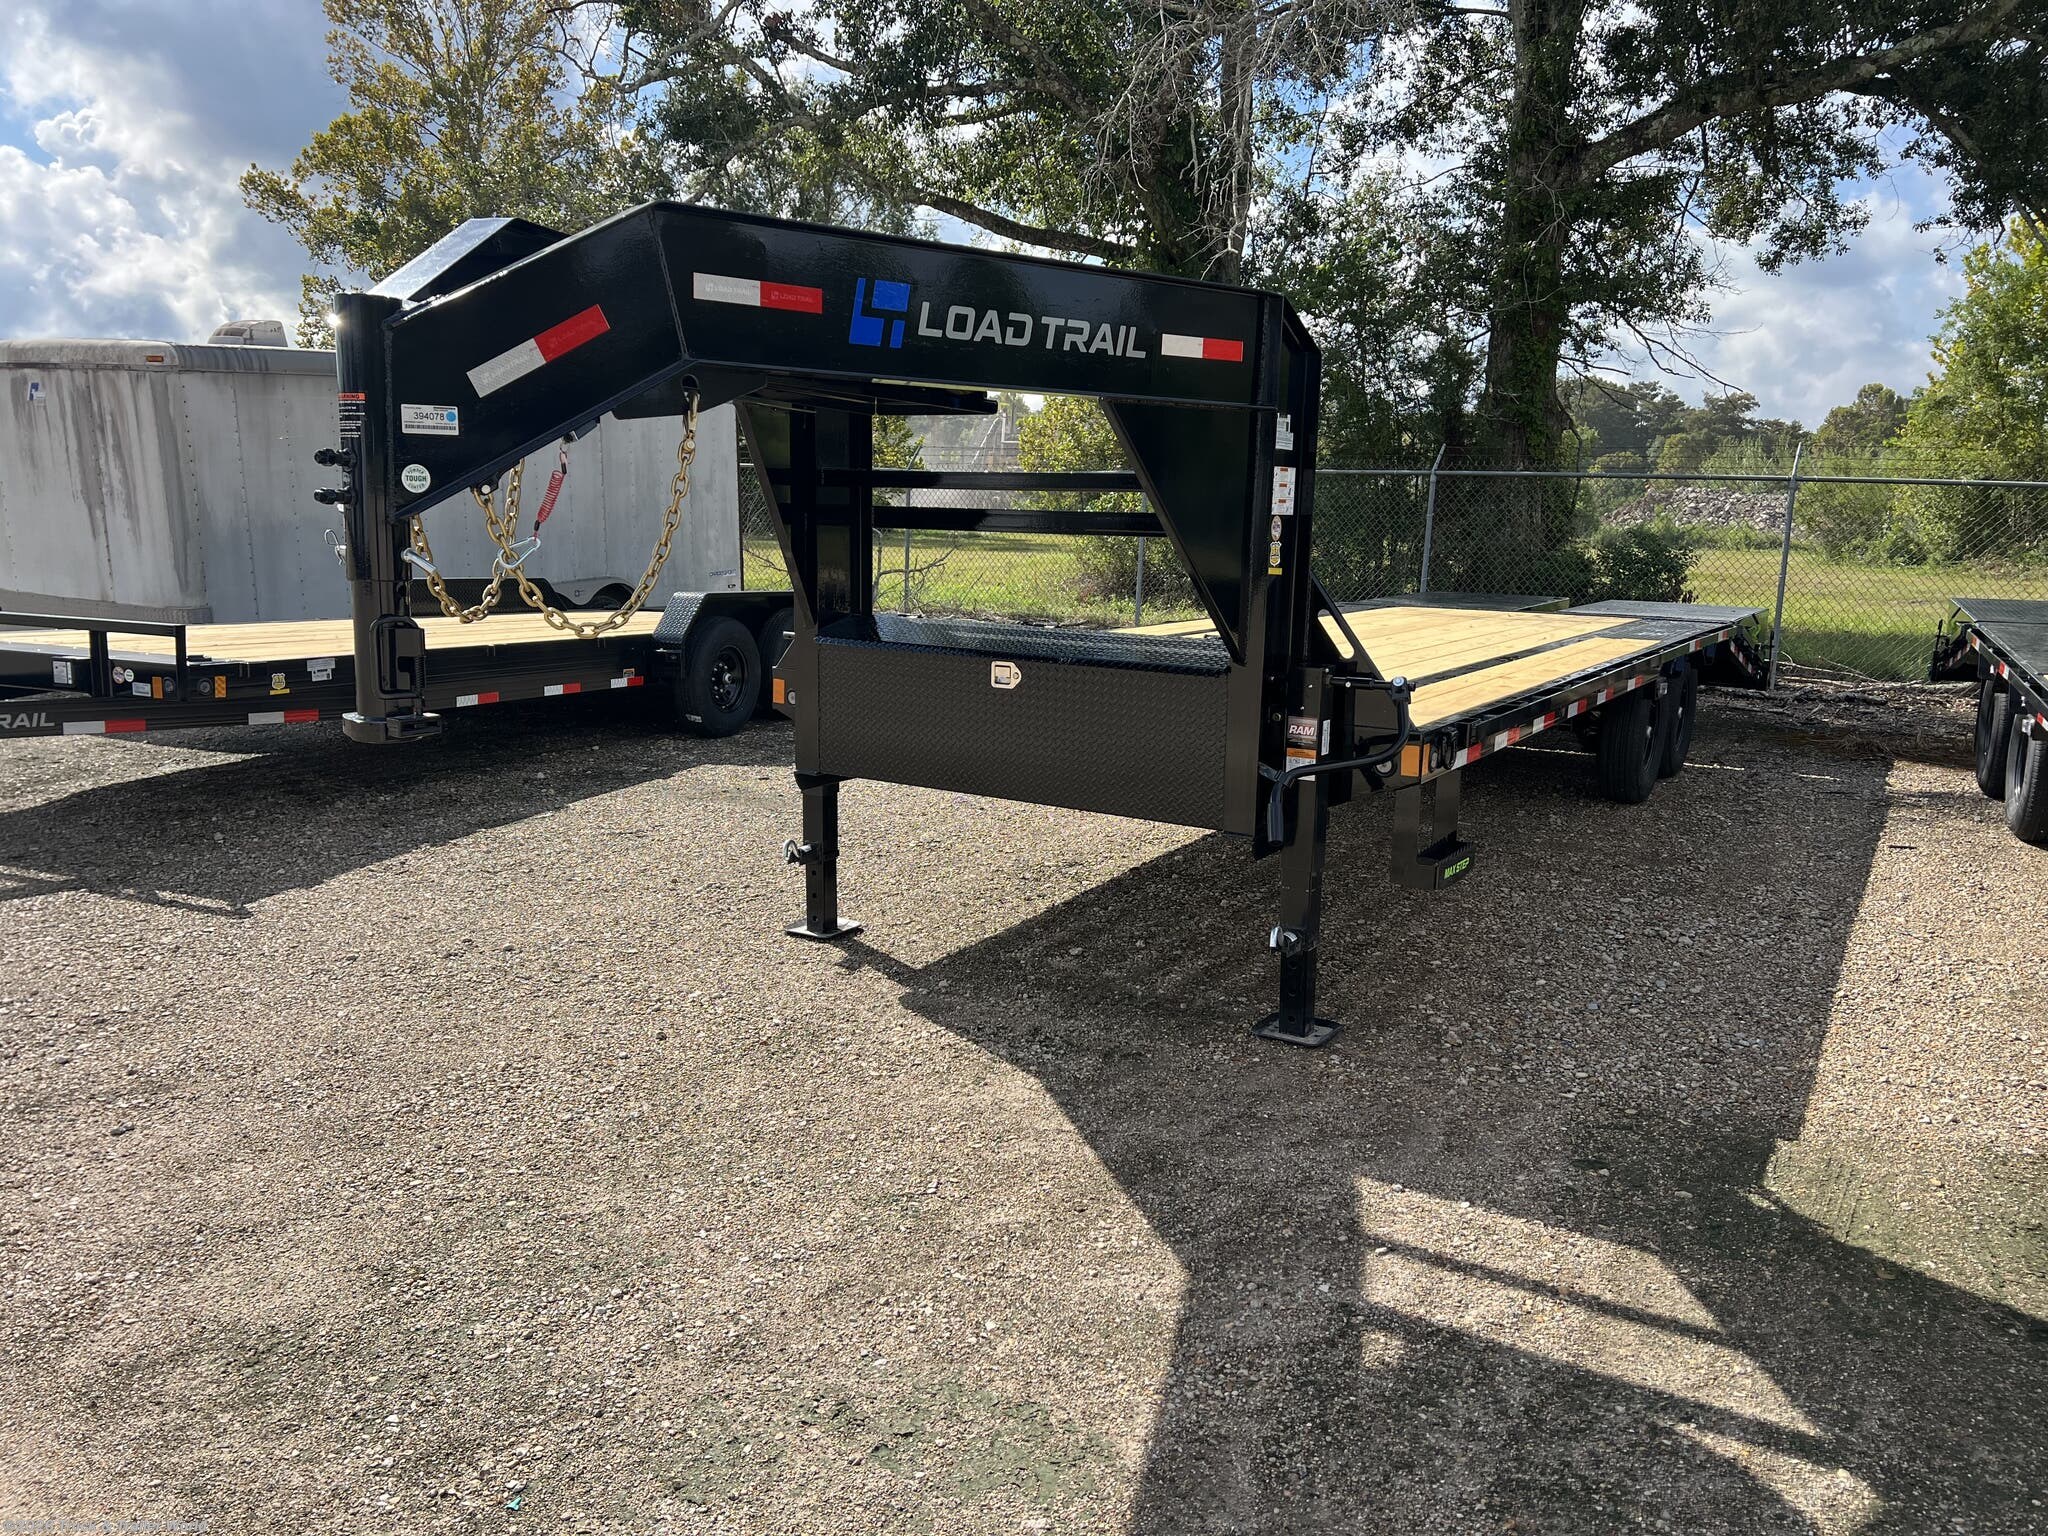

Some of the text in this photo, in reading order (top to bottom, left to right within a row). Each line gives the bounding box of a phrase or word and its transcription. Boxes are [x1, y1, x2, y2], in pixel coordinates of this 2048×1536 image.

[917, 301, 1147, 359] LOAD TRAIL
[413, 412, 445, 421] 394078
[1289, 724, 1315, 736] RAM
[1443, 857, 1470, 879] MAX STEP
